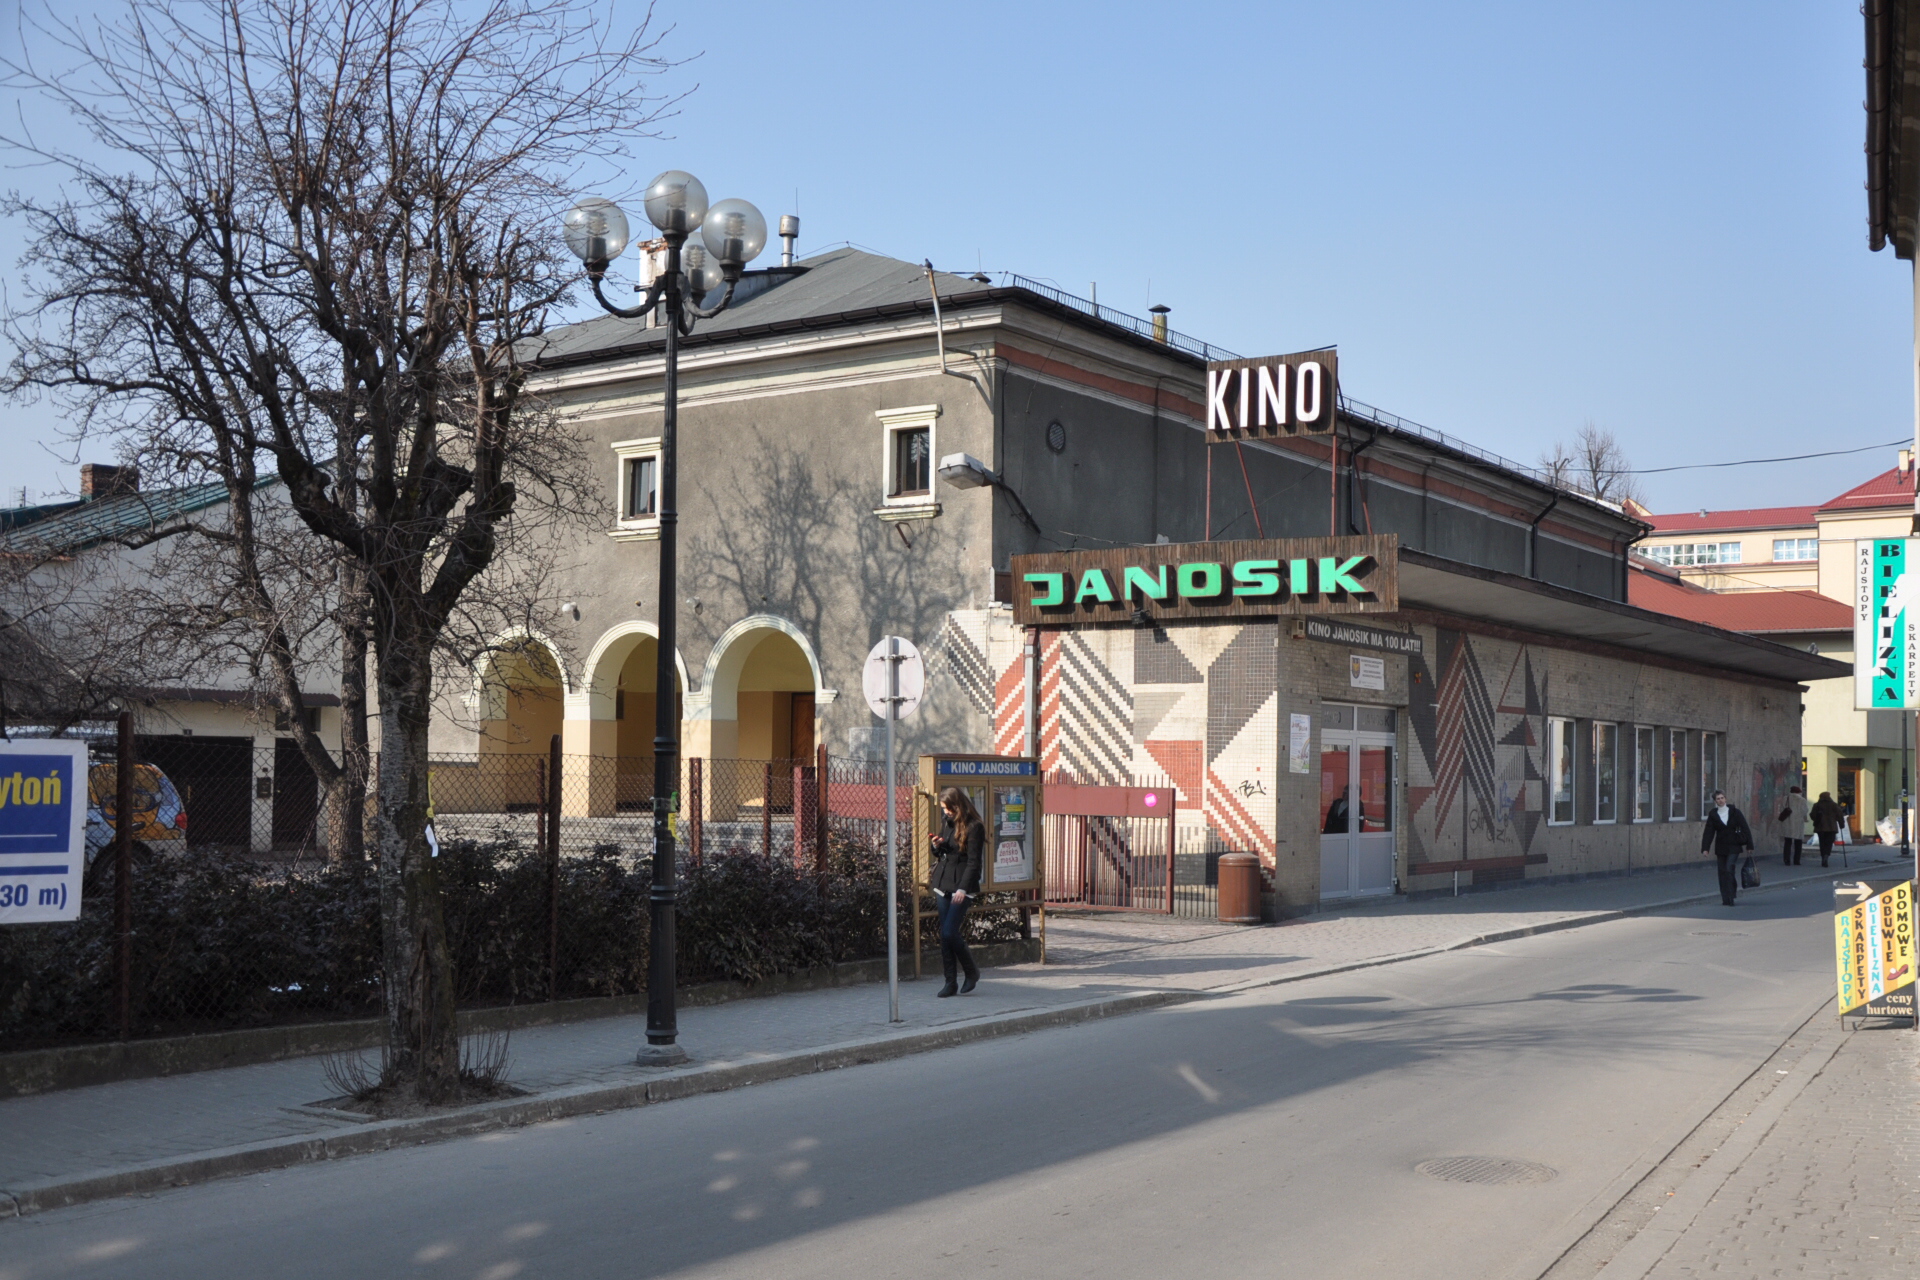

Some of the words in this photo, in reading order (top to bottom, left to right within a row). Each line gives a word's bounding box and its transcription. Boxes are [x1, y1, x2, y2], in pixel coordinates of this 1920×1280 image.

[1208, 361, 1321, 430] KINO
[1023, 554, 1374, 606] JANOSIK
[1861, 548, 1869, 621] RAJSTOPY
[1308, 622, 1331, 638] KINO
[1332, 626, 1369, 645] JANOSIK
[1371, 633, 1383, 647] MA
[1385, 635, 1399, 649] 100
[1400, 638, 1421, 652] LAT!!!
[1879, 544, 1900, 700] BIELIZNA
[1908, 623, 1916, 698] SKARPETY
[951, 762, 976, 774] KINO
[978, 762, 1020, 774] JANOSIK
[1001, 841, 1017, 849] wojna
[38, 882, 68, 911] m)
[1881, 895, 1895, 963] OBUWIE
[1896, 889, 1910, 957] DOMOWE
[1841, 915, 1853, 1007] RAJSTOPY
[1854, 907, 1866, 1000] SKARPETY
[1869, 902, 1881, 994] BIELIZNA
[1866, 1003, 1913, 1015] hurtowe
[1886, 994, 1913, 1006] ceny
